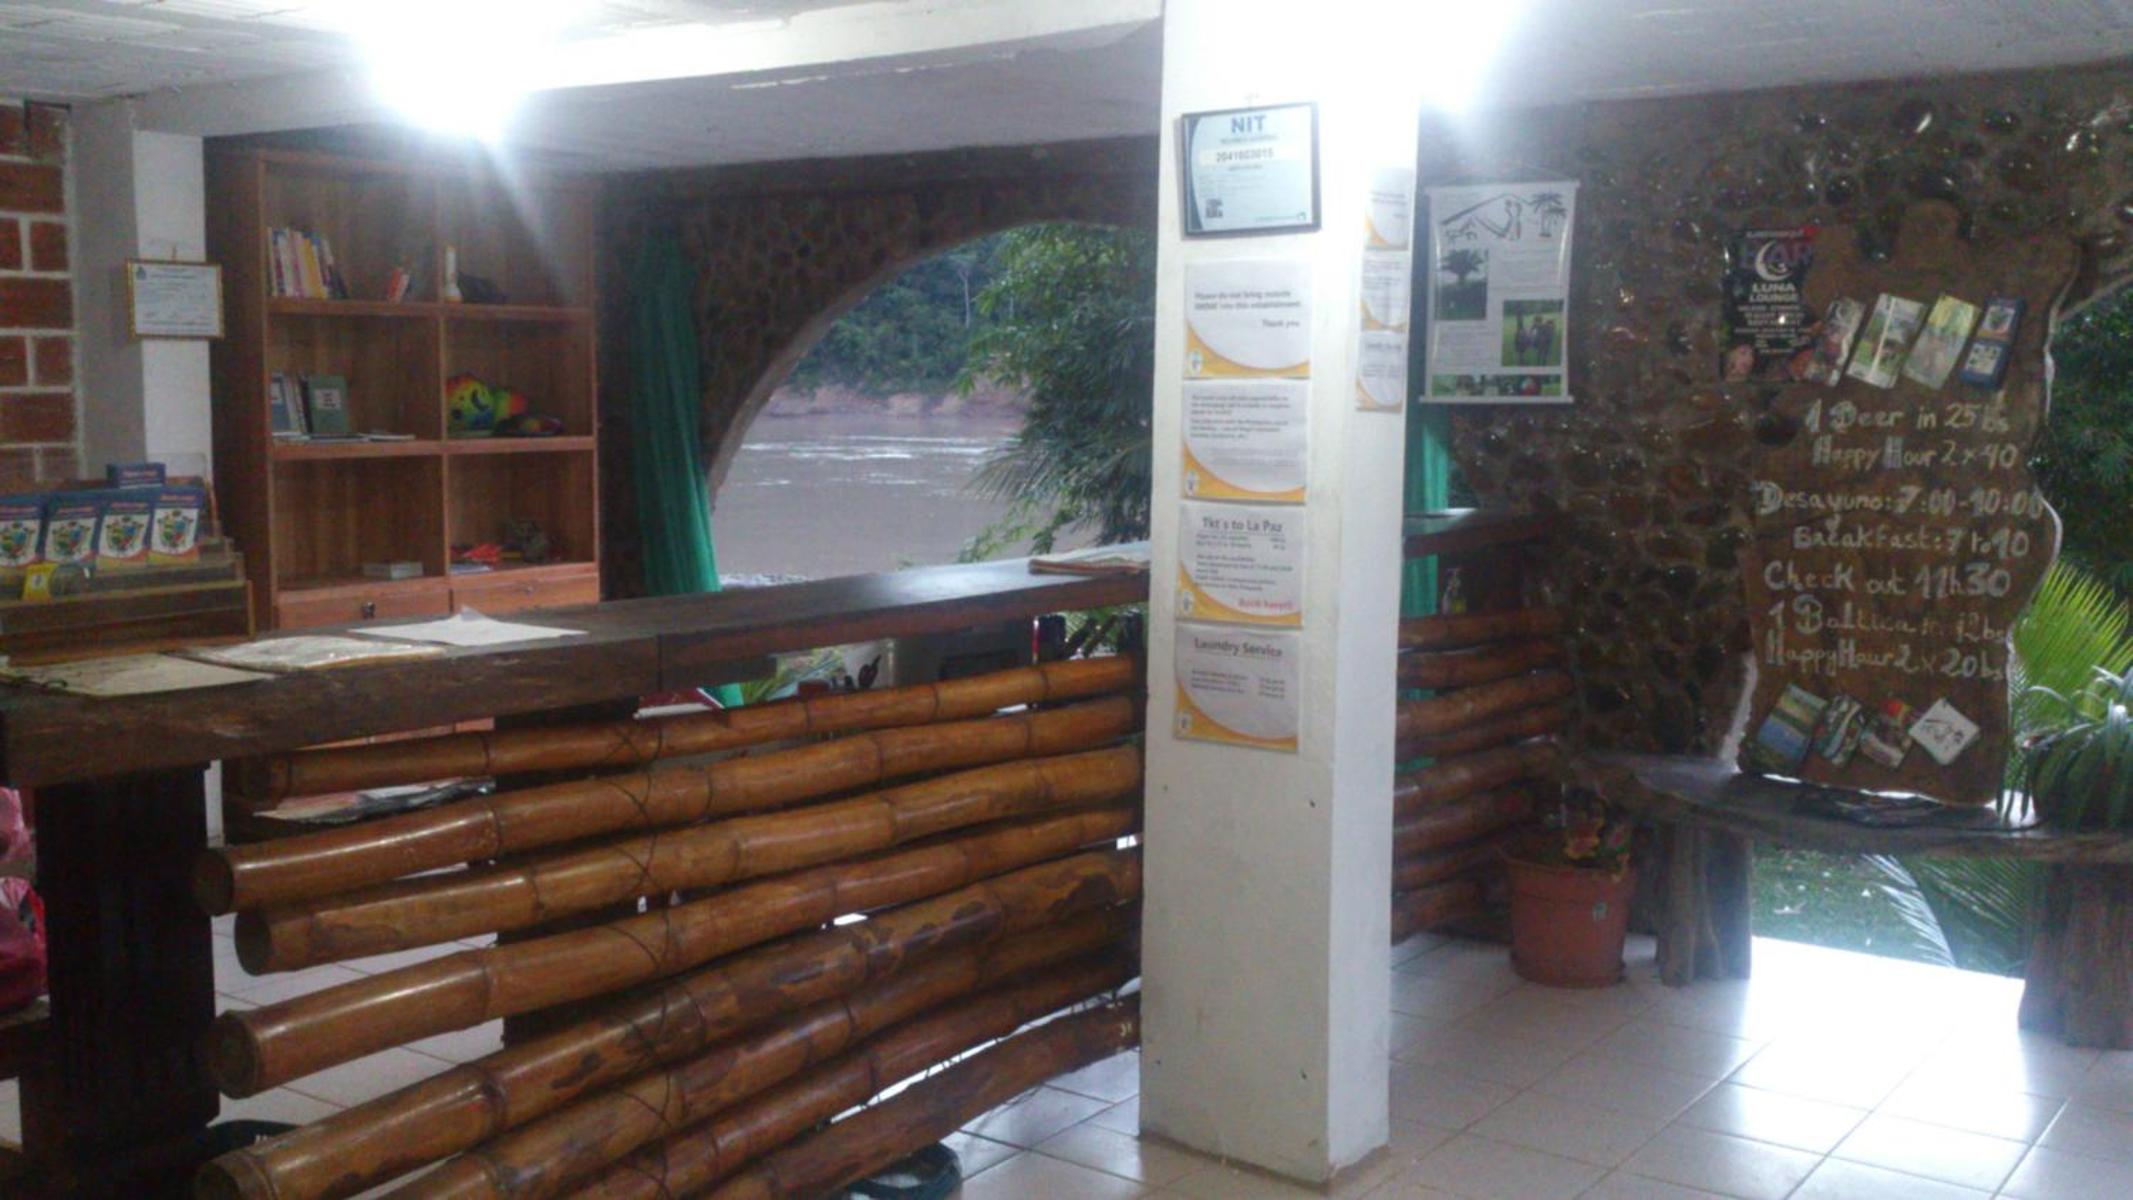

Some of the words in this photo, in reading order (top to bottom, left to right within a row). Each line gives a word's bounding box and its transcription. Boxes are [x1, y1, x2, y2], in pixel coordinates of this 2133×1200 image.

[1231, 114, 1267, 135] NIT
[1752, 283, 1796, 293] LUNA
[1812, 435, 1881, 471] Happy
[1882, 435, 1937, 468] Hour
[1231, 520, 1245, 530] to
[1246, 520, 1260, 531] La
[1263, 520, 1283, 532] Paz
[1194, 637, 1239, 656] Laundry
[1242, 642, 1283, 657] Service
